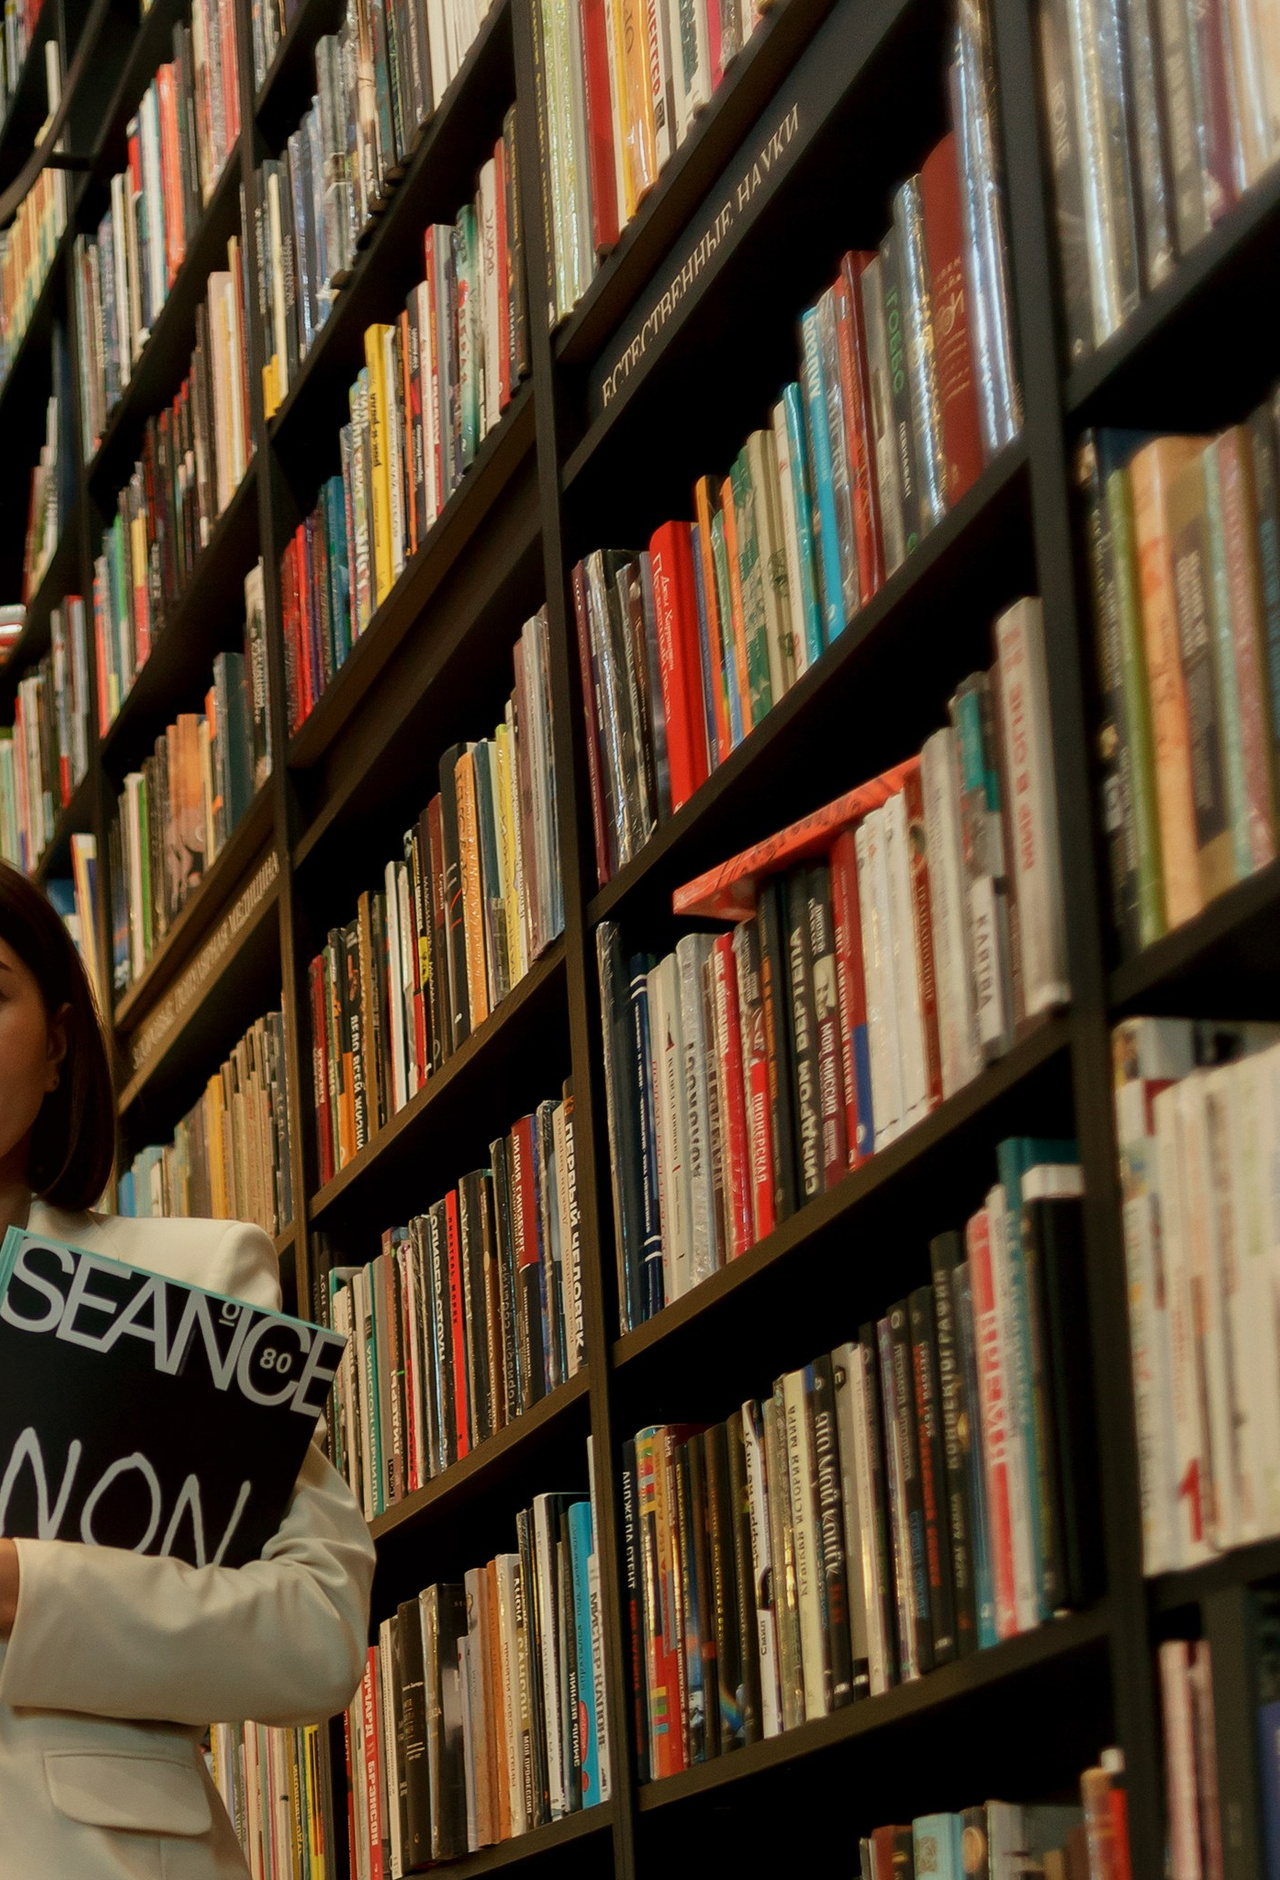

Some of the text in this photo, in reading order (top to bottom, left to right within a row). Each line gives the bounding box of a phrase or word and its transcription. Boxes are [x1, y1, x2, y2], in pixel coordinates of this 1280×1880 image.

[602, 102, 799, 408] ЕСТЕСТВЕННЫЕ НАУКИ
[900, 421, 911, 499] ЛЕВИАФАН
[351, 1015, 366, 1152] ДЕЛО ВСЕЙ ЖИЗНИ
[820, 1022, 837, 1116] МОЯ МИССИЯ
[752, 1092, 767, 1184] ПИОНЕРСКАЯ
[797, 1060, 818, 1196] СИНДРОМ
[513, 1134, 525, 1252] ЛИДИЯ ГИНЗБУРГ
[565, 1121, 584, 1348] ПЕРВЫЙ ЧЕЛОВЕК
[0, 1239, 348, 1417] SEANCE
[431, 1215, 445, 1360] ОЛИВЕР СТОУН
[259, 1347, 293, 1374] 80
[366, 1345, 378, 1512] УИНСТОН ЧЕРЧИЛЛЬ
[390, 1369, 400, 1455] ЛИДЕРЫ
[787, 1404, 798, 1447] МИРА
[623, 1471, 633, 1542] АНДЖЕЛА
[792, 1454, 804, 1525] ИСТОРИЯ
[626, 1545, 636, 1589] СТЕНТ
[590, 1591, 606, 1750] МИСТЕР КАПОНЕ
[759, 1619, 768, 1656] Смил
[364, 1661, 378, 1846] РИЧАРД БРЭНСОН
[504, 1641, 516, 1788] ПРОЙТИ СКВОЗЬ СТЕНЫ
[546, 1707, 554, 1763] ОБАМА
[569, 1671, 580, 1767] ЭМИЛЬ ВЕРНИК
